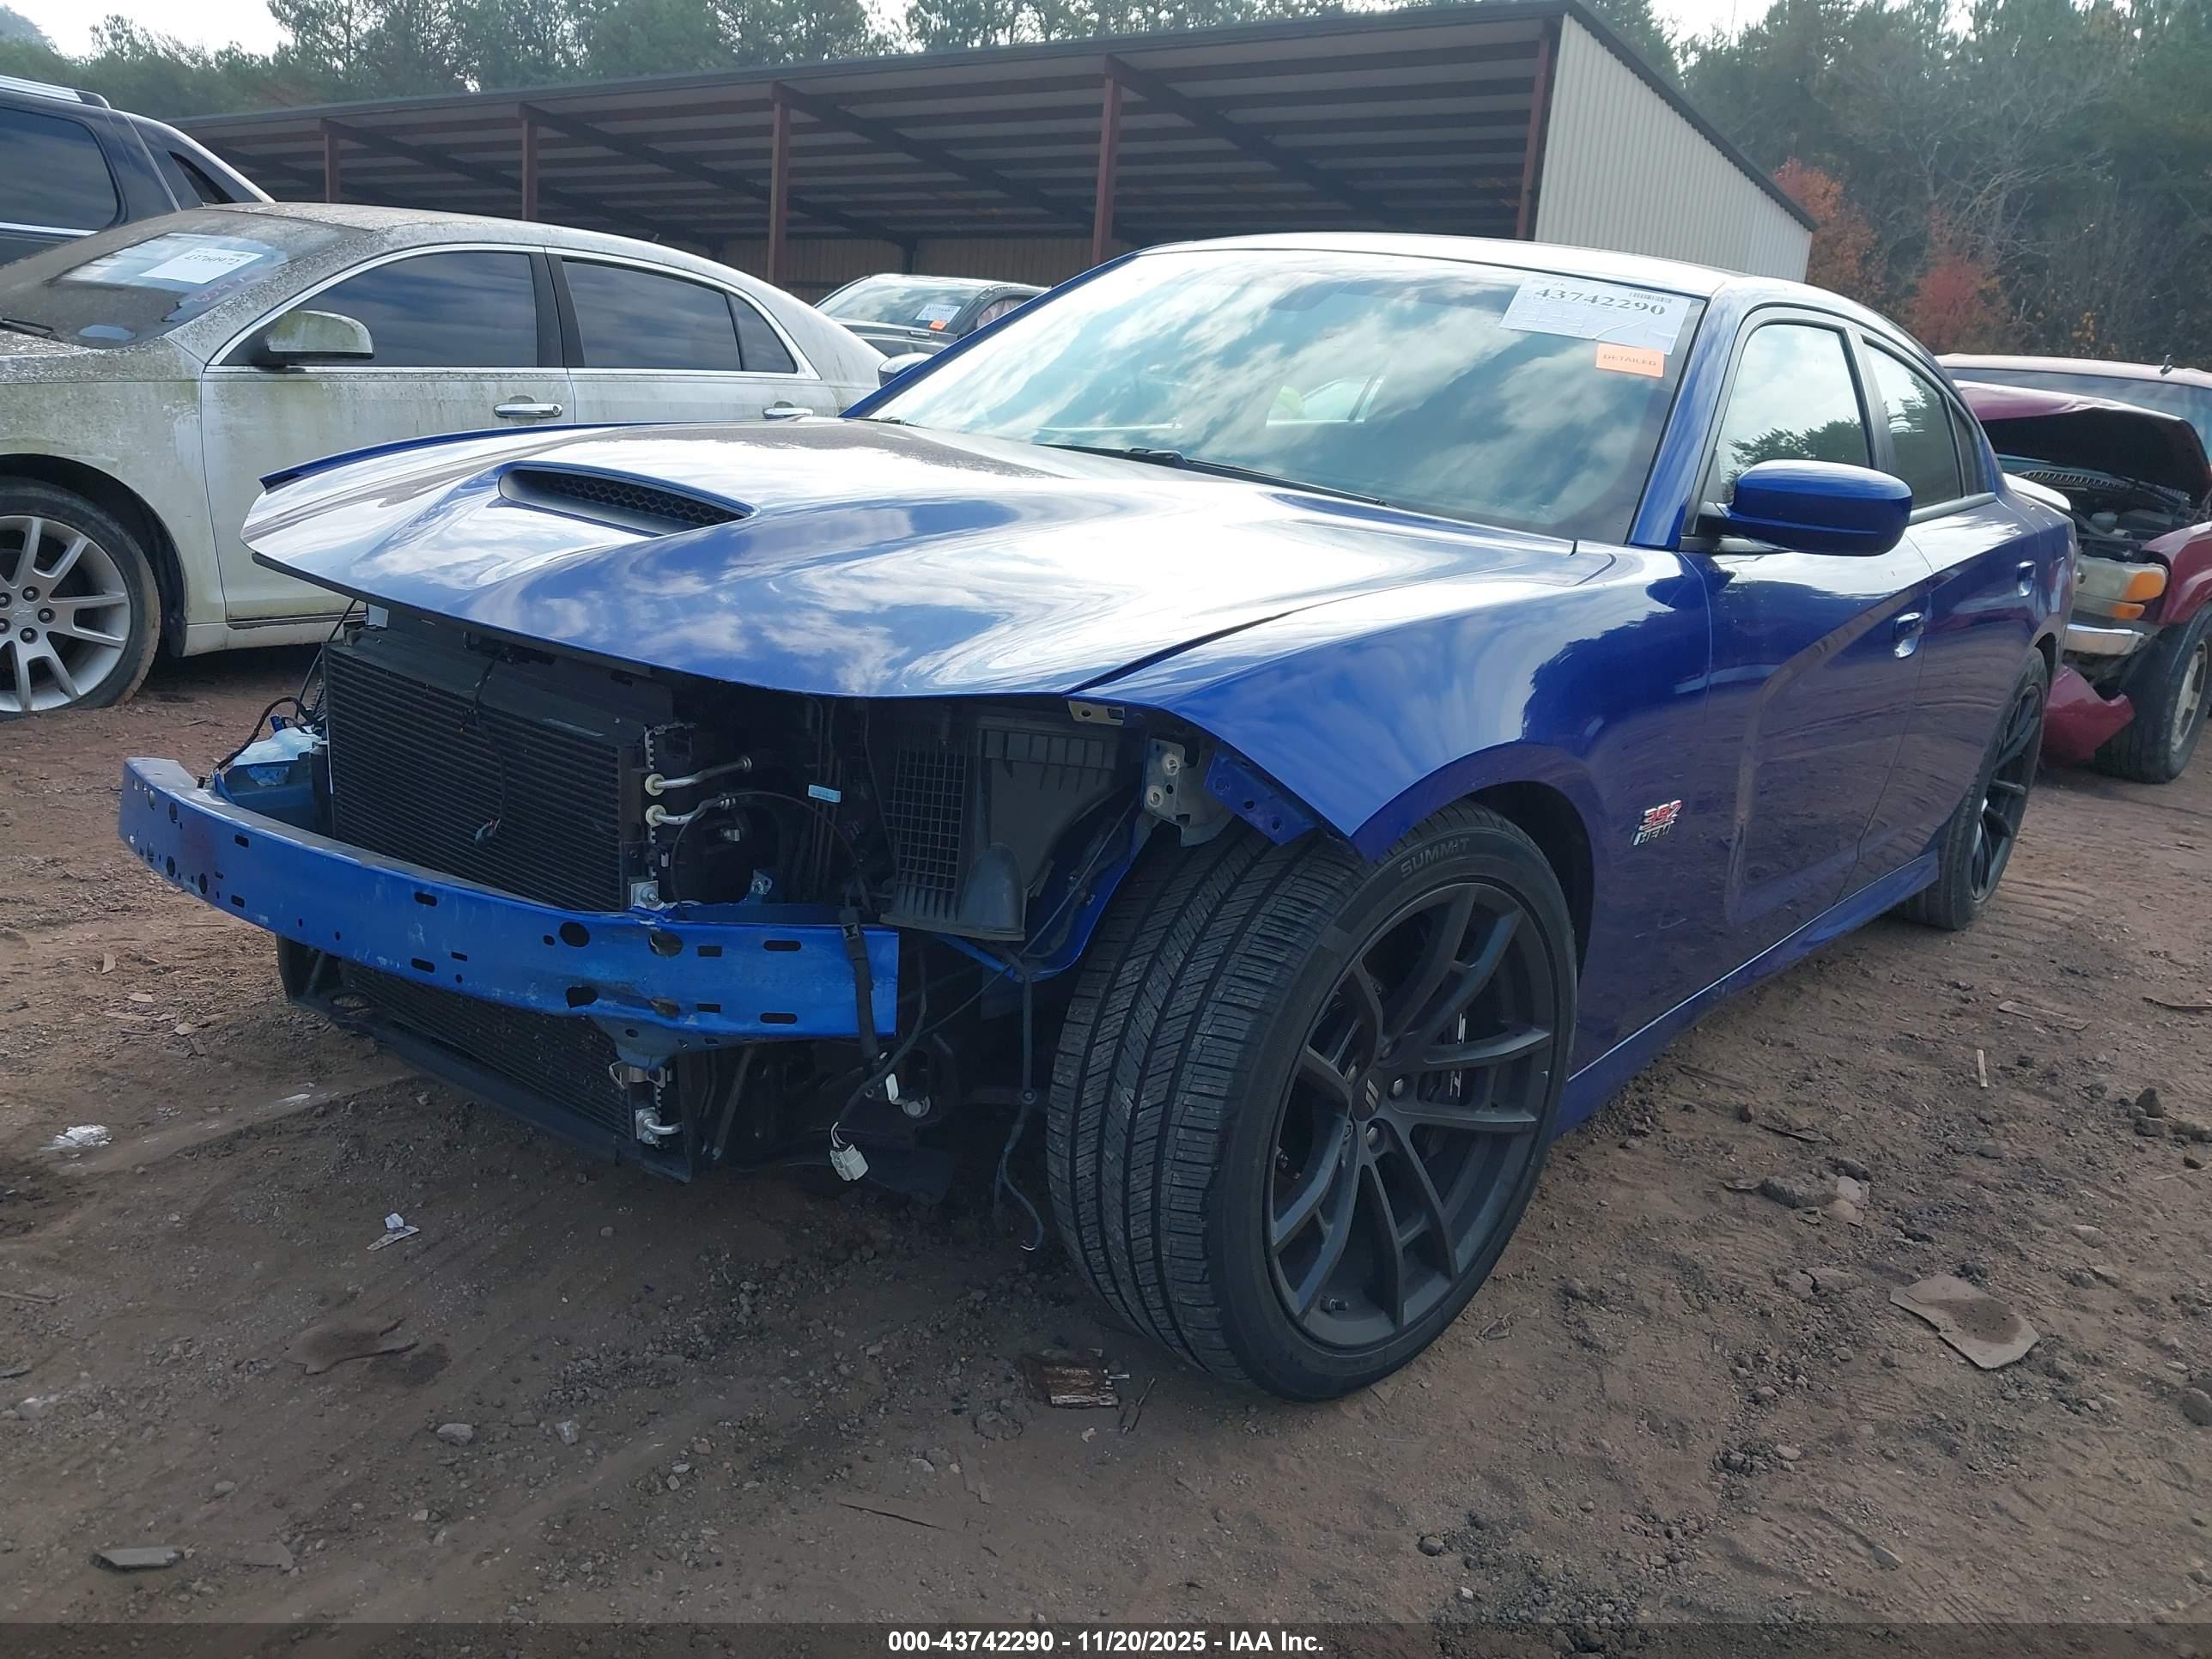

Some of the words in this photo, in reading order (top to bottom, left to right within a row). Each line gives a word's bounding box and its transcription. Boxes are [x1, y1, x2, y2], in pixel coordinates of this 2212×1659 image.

[1535, 289, 1666, 315] 43742290
[1602, 354, 1657, 367] DETAILED
[1638, 799, 1683, 830] 392
[1401, 837, 1470, 878] SUMMIT
